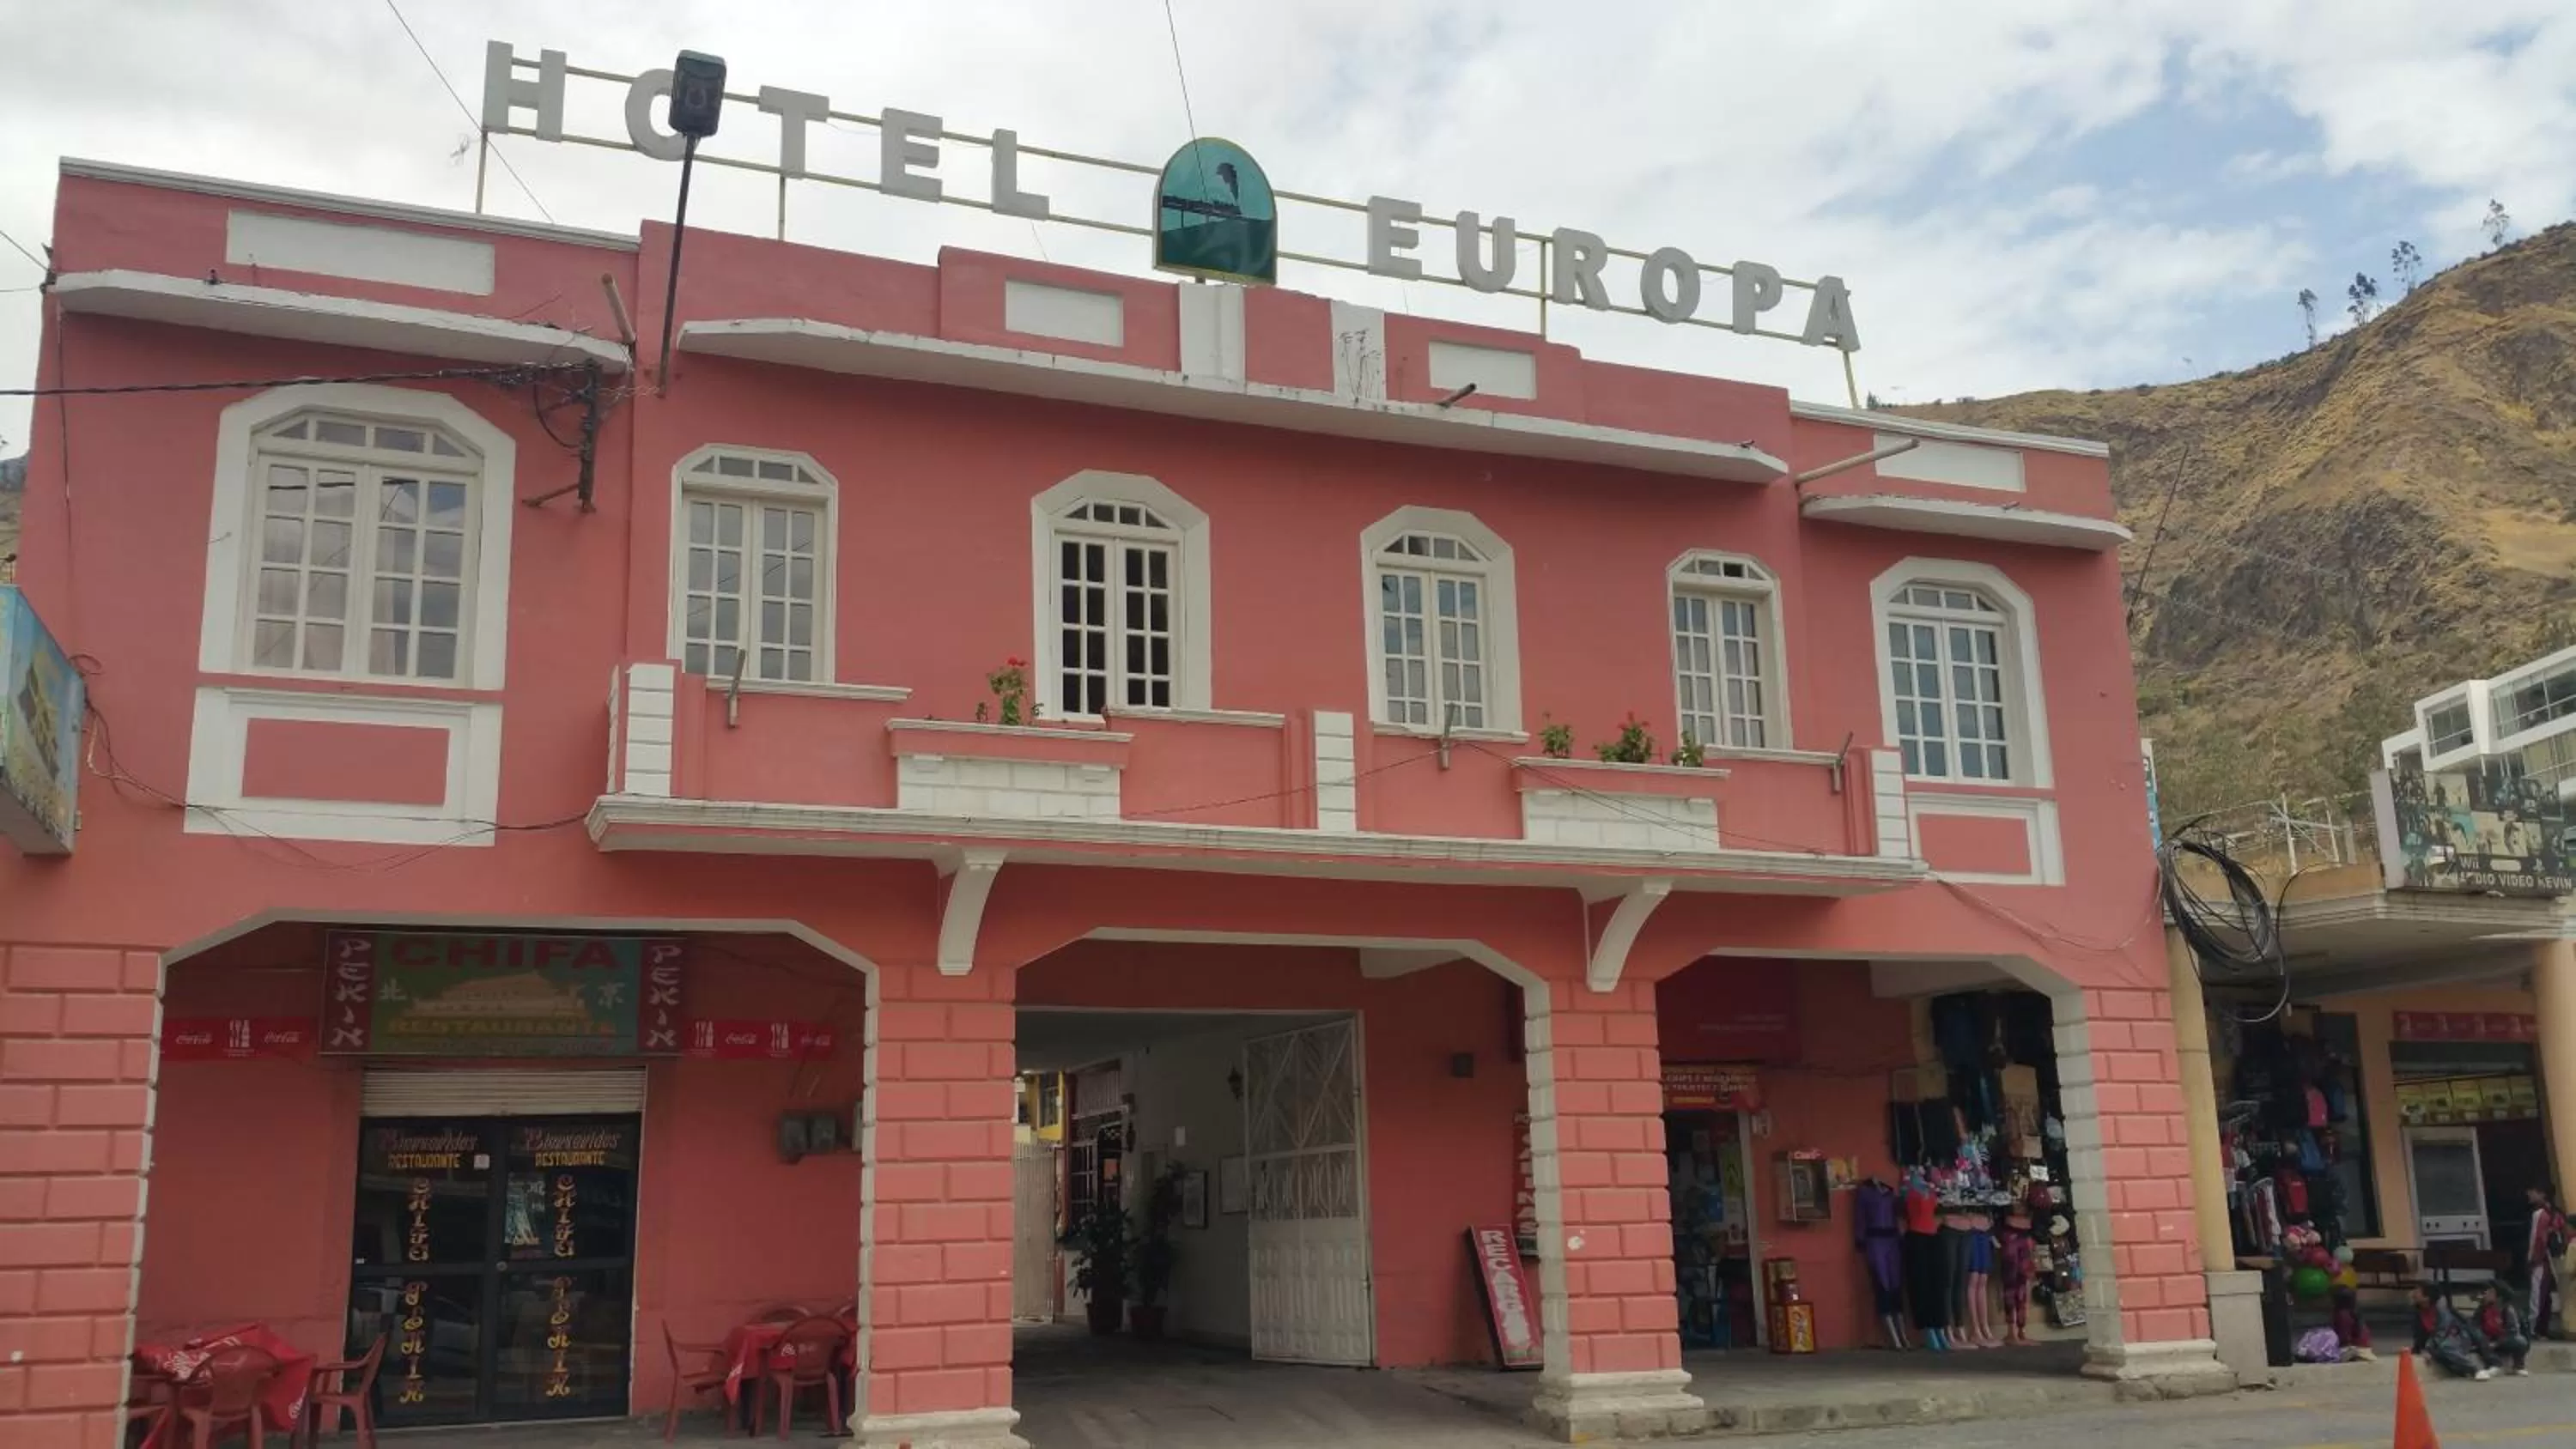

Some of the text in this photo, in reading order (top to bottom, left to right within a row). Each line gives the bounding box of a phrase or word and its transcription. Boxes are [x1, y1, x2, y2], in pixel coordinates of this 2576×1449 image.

[485, 40, 1862, 351] HOTEL EUROPA
[2499, 873, 2534, 888] VIDEO
[391, 938, 620, 969] CHIFA
[388, 1018, 617, 1037] RESTAURANTE
[535, 1152, 605, 1167] RESTAURANTE
